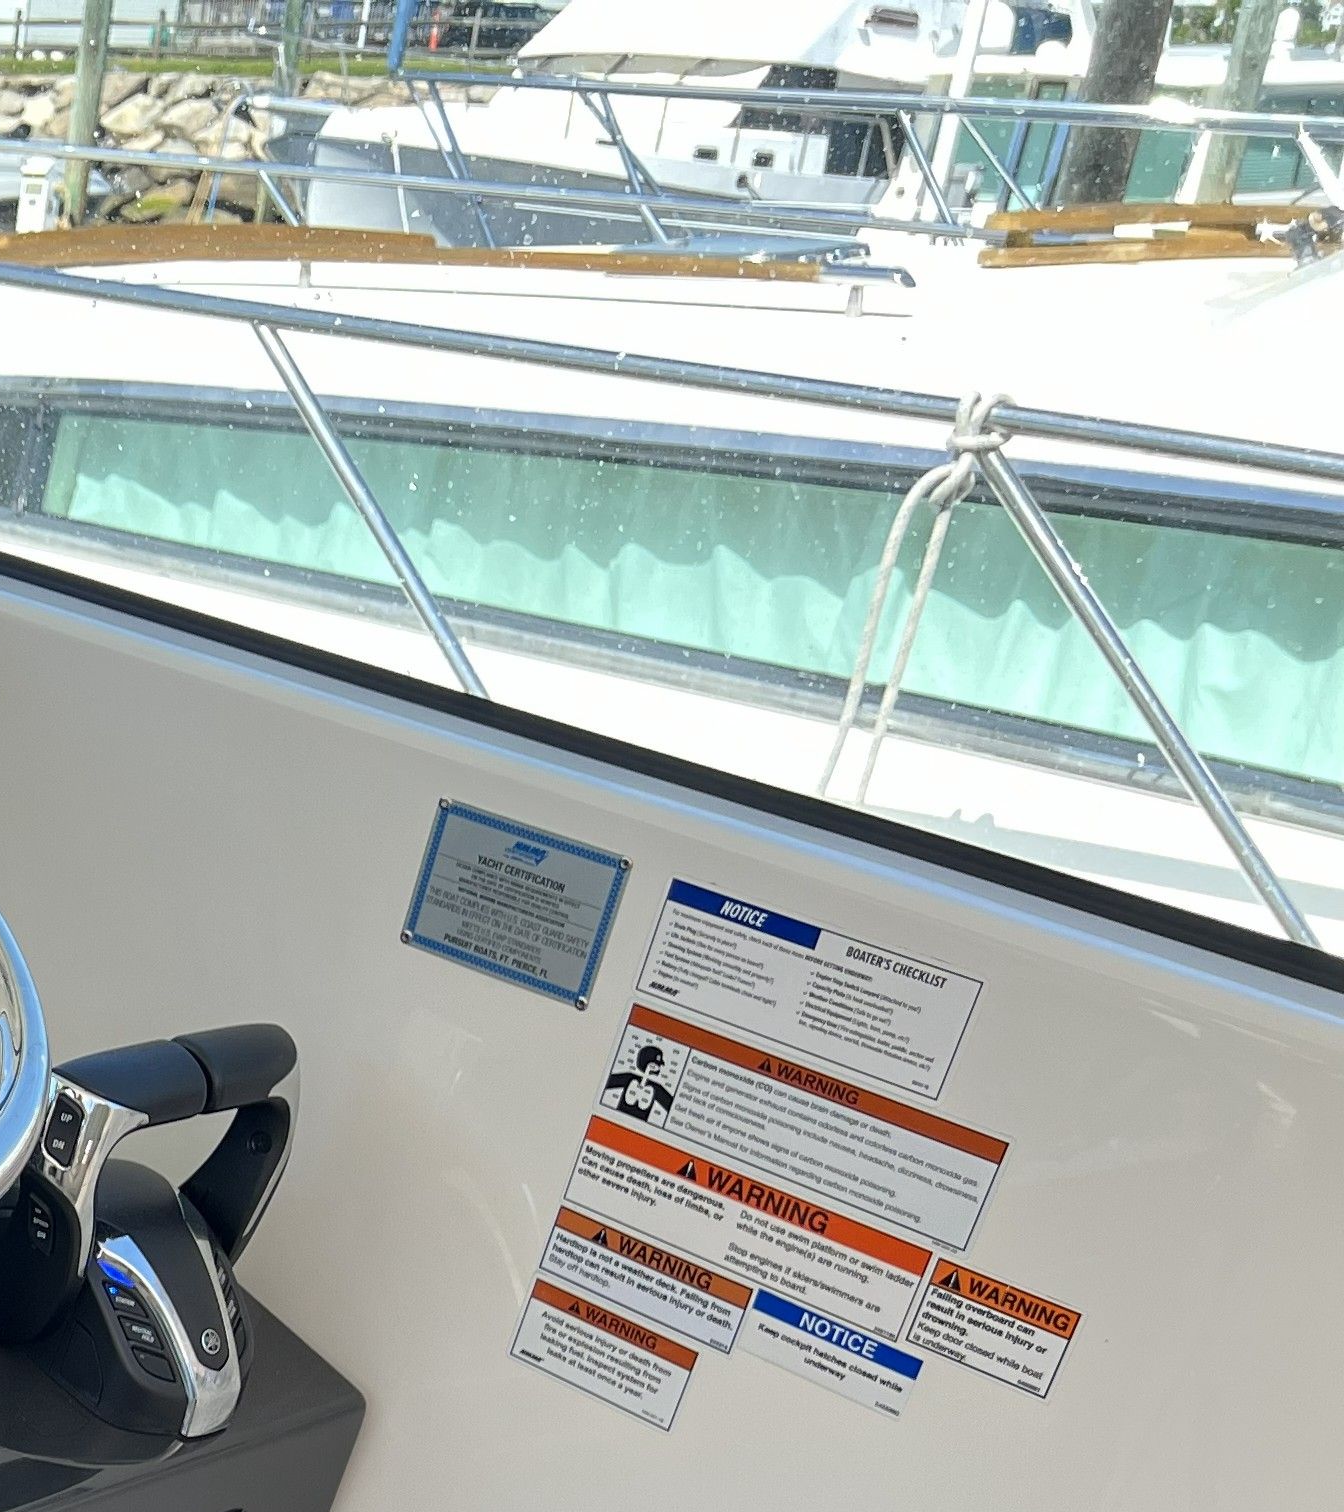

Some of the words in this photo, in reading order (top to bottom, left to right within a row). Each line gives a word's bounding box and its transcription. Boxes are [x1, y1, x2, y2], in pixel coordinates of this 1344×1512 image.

[476, 854, 504, 872] YACHT
[503, 863, 565, 893] CERTIFICATION
[719, 899, 768, 928] NOTICE
[845, 945, 892, 971] BOATER'S
[891, 961, 947, 989] CHECKLIST
[774, 1062, 860, 1106] WARNING
[60, 1112, 73, 1125] UP
[577, 1166, 600, 1181] other
[600, 1177, 629, 1194] severe
[580, 1155, 599, 1169] Can
[598, 1164, 625, 1180] cause
[653, 1186, 673, 1200] loss
[673, 1194, 684, 1205] of
[712, 1212, 724, 1222] or
[584, 1145, 616, 1165] Moving
[615, 1159, 660, 1183] propellers
[660, 1178, 676, 1189] are
[703, 1167, 831, 1235] WARNING
[615, 1235, 714, 1291] WARNING
[735, 1220, 759, 1236] while
[758, 1230, 774, 1243] the
[774, 1237, 816, 1262] engine(s)
[816, 1255, 833, 1268] are
[739, 1209, 754, 1222] Do
[753, 1216, 769, 1228] not
[769, 1223, 786, 1236] use
[786, 1230, 810, 1245] swim
[810, 1239, 848, 1261] platform
[848, 1256, 859, 1266] or
[859, 1260, 884, 1276] swim
[884, 1270, 915, 1289] ladder
[925, 1299, 954, 1317] result
[954, 1310, 966, 1321] in
[966, 1316, 1004, 1337] serious
[1003, 1331, 1035, 1351] injury
[1034, 1344, 1047, 1355] or
[929, 1288, 964, 1309] Falling
[963, 1302, 1015, 1328] overboard
[1015, 1323, 1036, 1337] can
[965, 1276, 1072, 1332] WARNING
[583, 1306, 658, 1351] WARNING
[798, 1311, 878, 1359] NOTICE
[912, 1332, 921, 1342] is
[916, 1321, 942, 1338] Keep
[941, 1332, 963, 1347] door
[963, 1341, 995, 1360] closed
[994, 1353, 1021, 1370] while
[1020, 1364, 1043, 1380] boat
